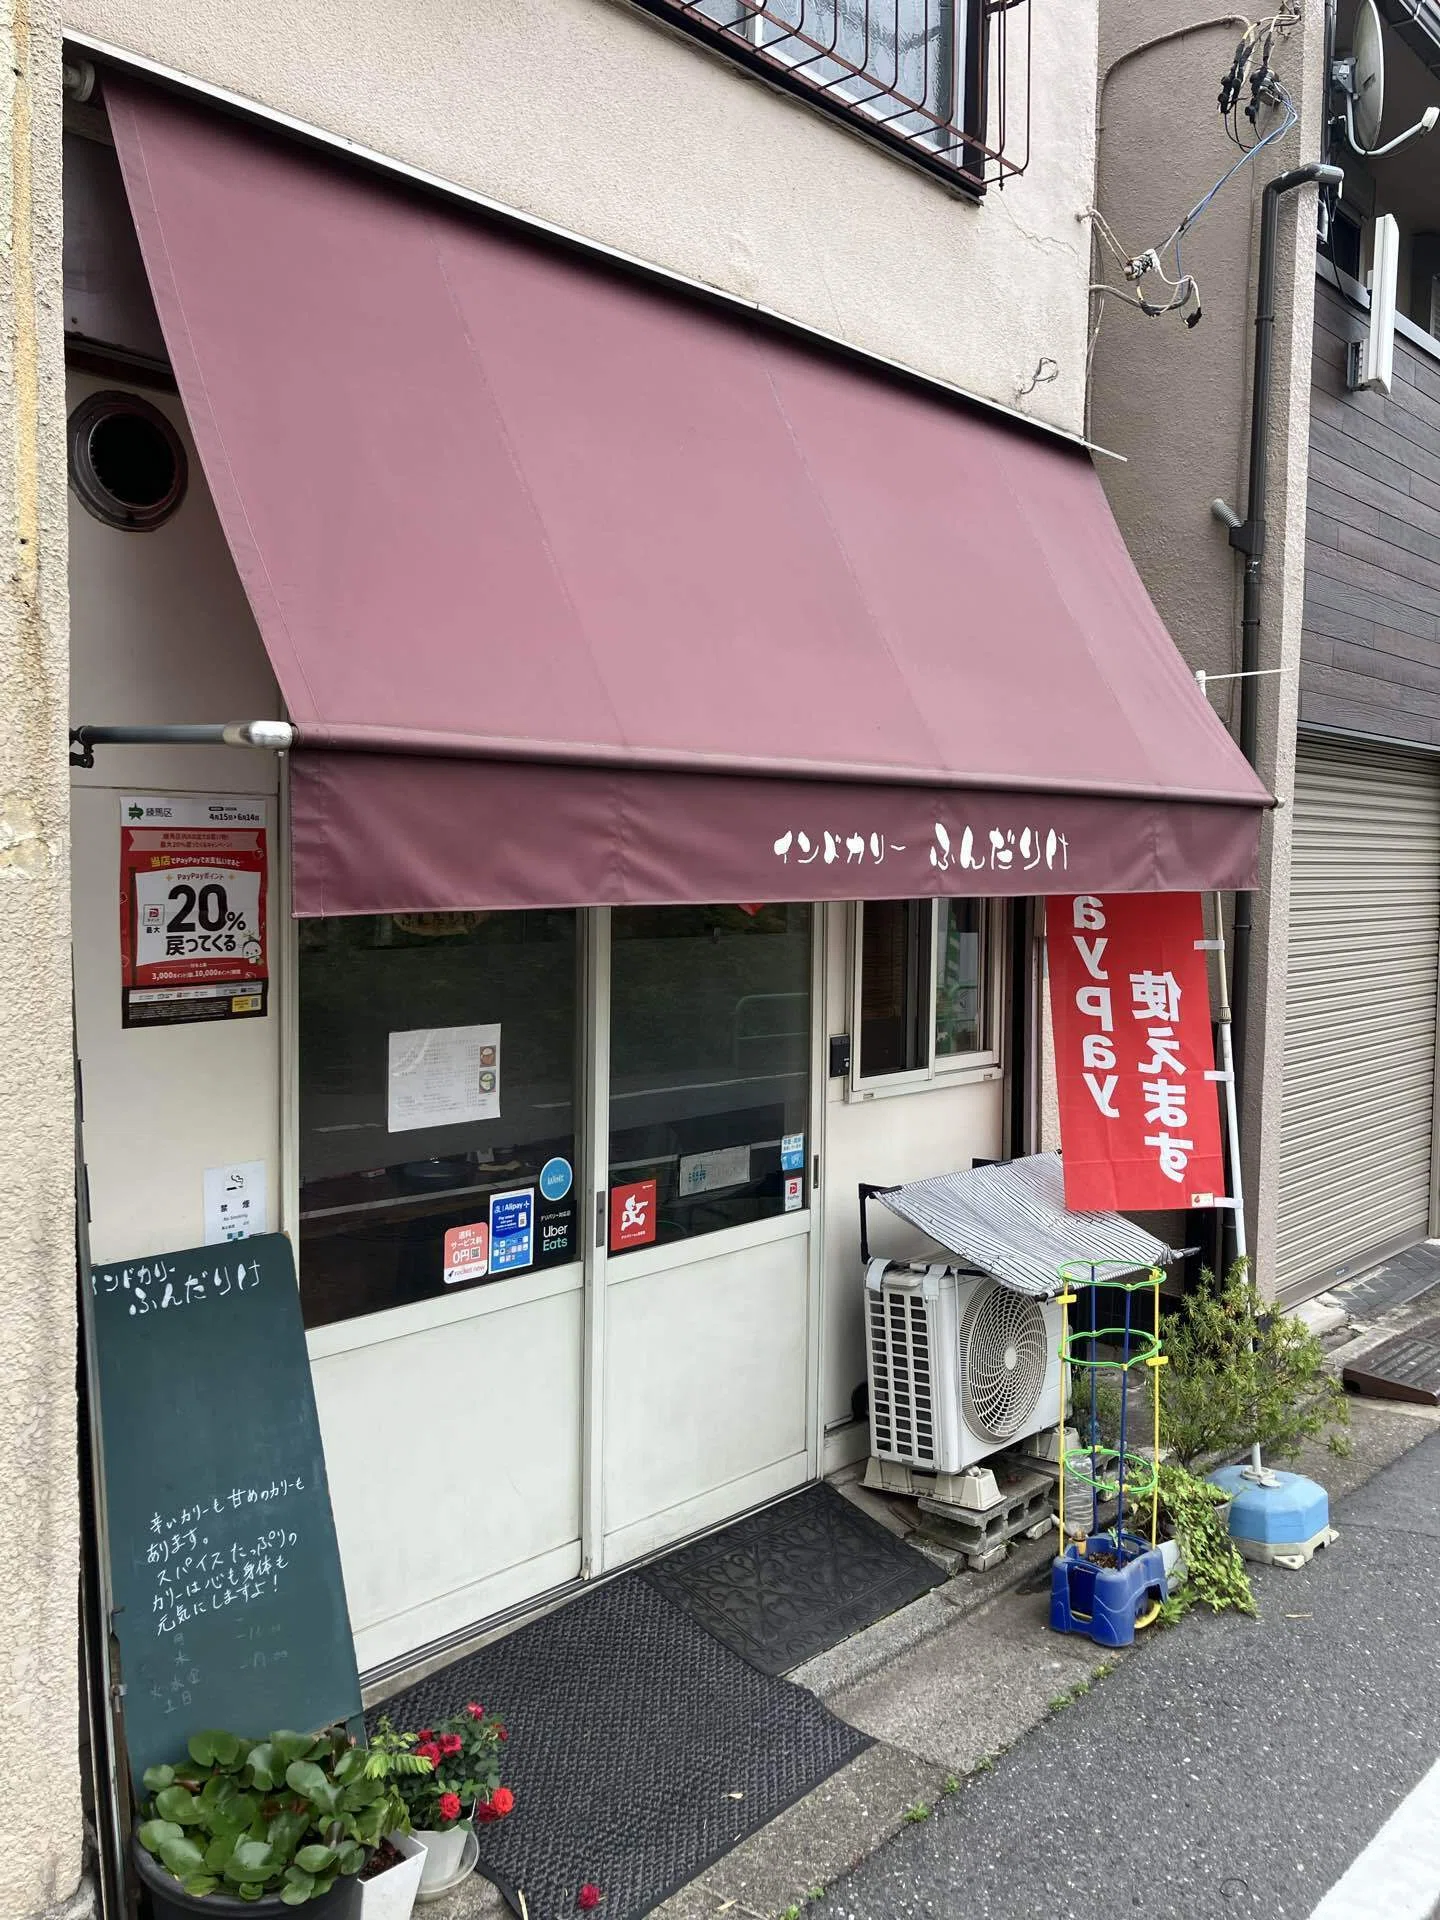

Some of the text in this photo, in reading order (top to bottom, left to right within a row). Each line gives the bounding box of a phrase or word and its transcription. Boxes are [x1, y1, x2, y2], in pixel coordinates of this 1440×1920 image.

[166, 883, 246, 933] 20%
[165, 934, 237, 956] 戻ってくる
[543, 1224, 569, 1238] Uber
[543, 1238, 568, 1251] Eats
[452, 1249, 470, 1264] 0円
[147, 1527, 209, 1564] あります。
